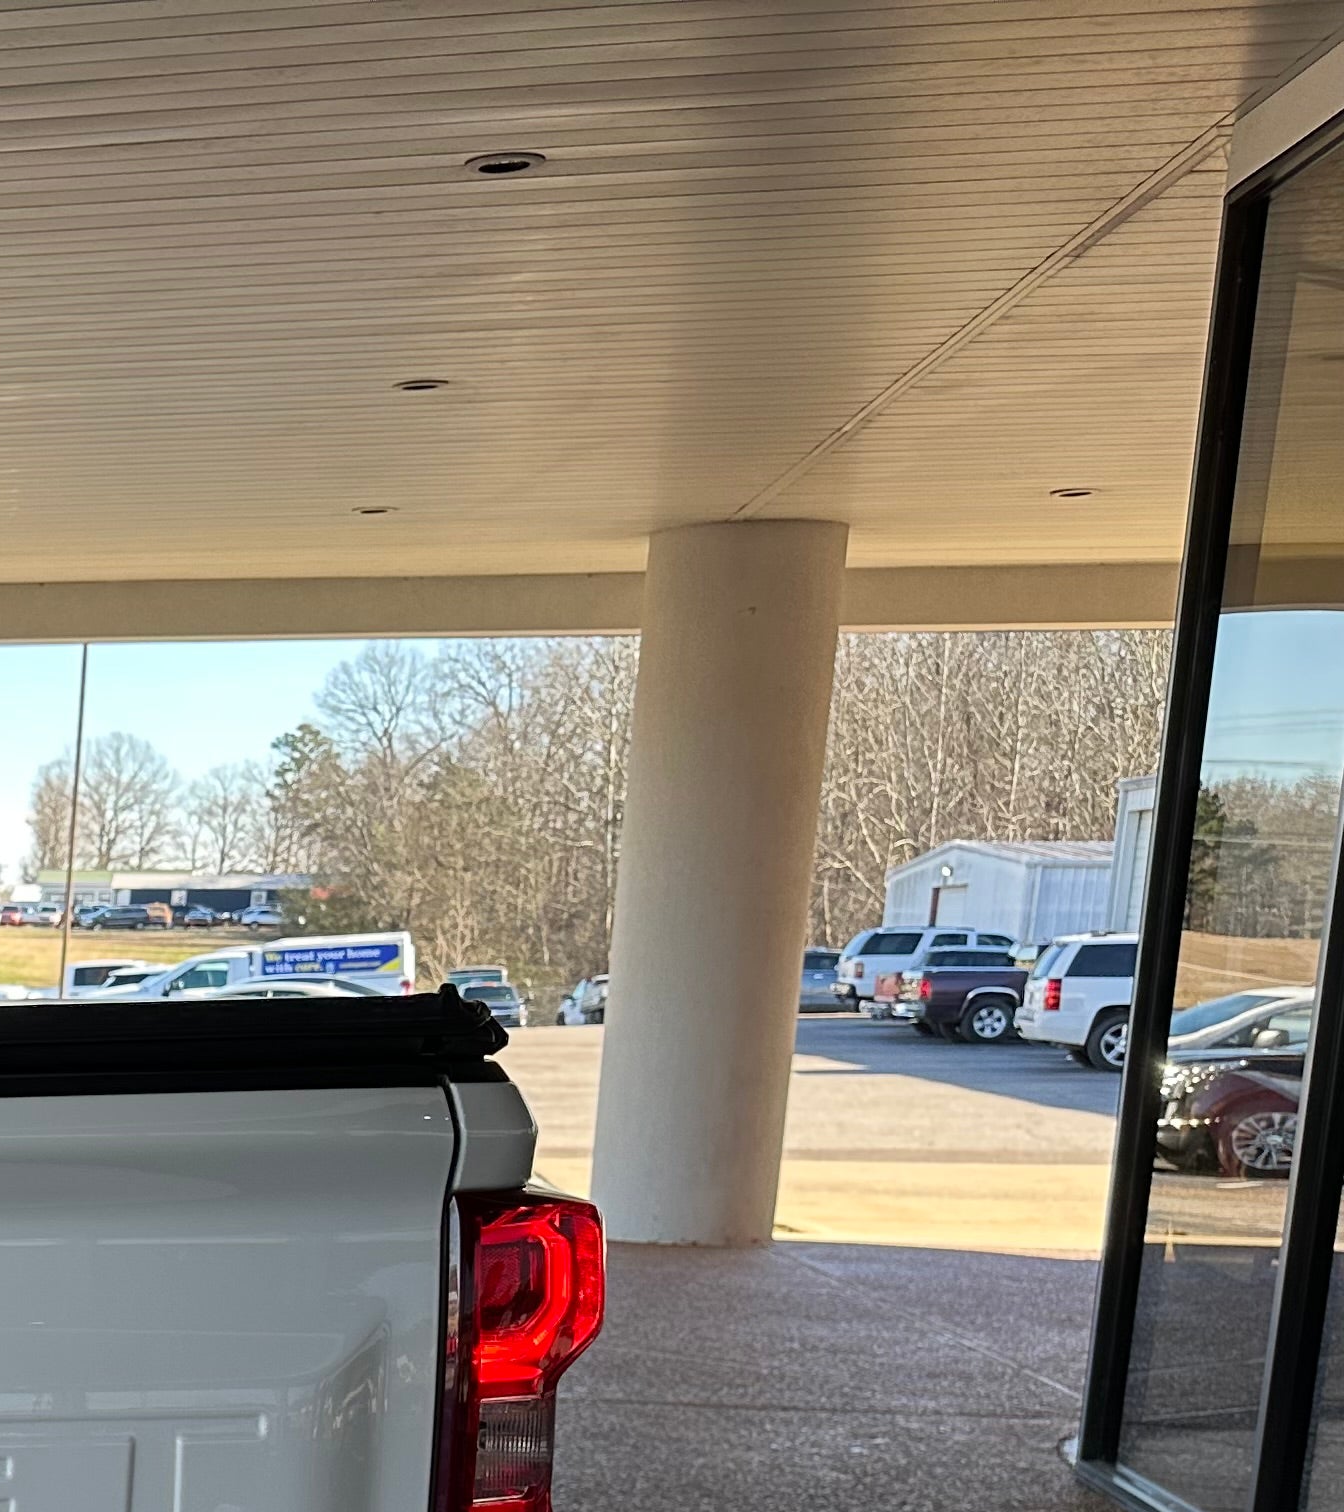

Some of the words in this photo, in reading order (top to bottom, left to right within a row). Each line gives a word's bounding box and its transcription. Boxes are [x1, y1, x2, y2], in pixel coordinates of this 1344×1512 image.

[284, 951, 315, 962] treat
[317, 950, 345, 962] your
[346, 948, 381, 959] home
[265, 962, 293, 973] with
